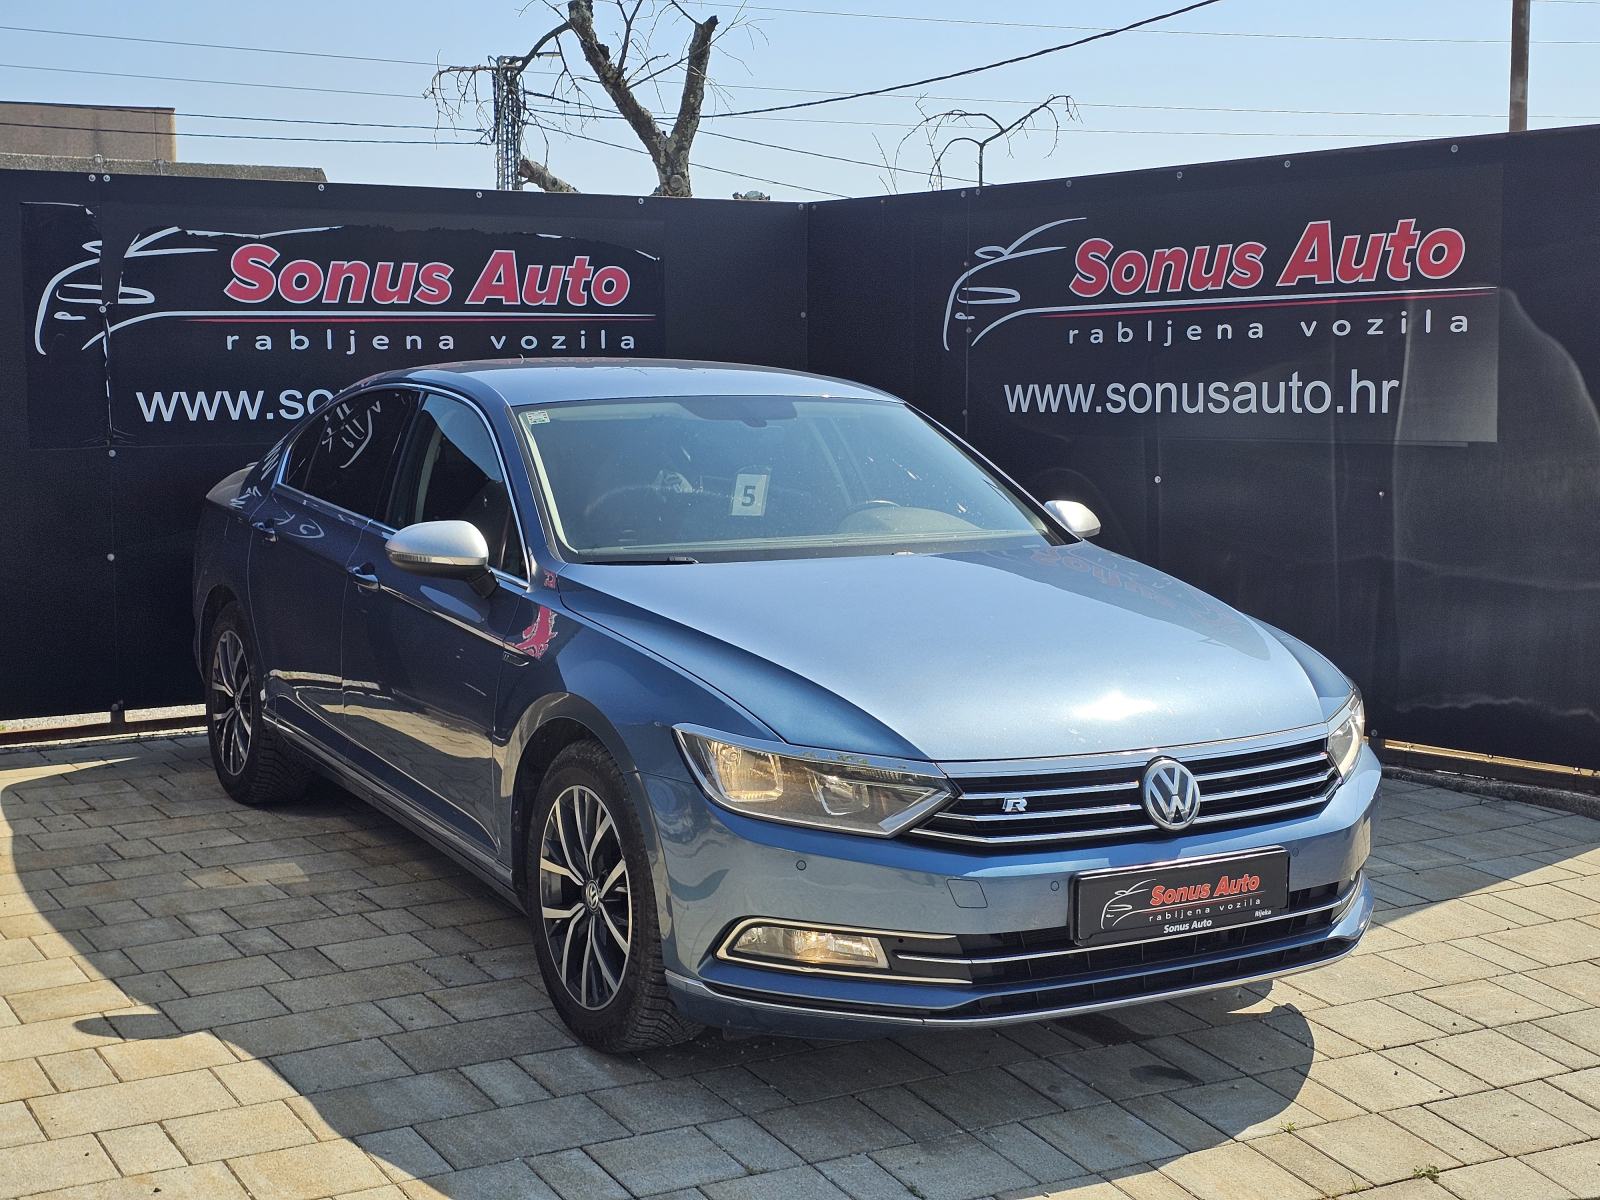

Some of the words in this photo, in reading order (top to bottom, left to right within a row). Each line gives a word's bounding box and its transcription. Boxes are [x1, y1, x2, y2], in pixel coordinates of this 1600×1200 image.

[223, 243, 455, 306] Sonus
[465, 249, 631, 306] Auto
[1068, 236, 1267, 298] Sonus
[1276, 217, 1466, 288] Auto
[225, 328, 455, 356] rabljena
[490, 328, 636, 351] vozila
[1068, 318, 1264, 347] rabljena
[1300, 309, 1470, 337] vozila
[135, 388, 343, 423] www.so
[1003, 368, 1400, 416] www.sonusauto.hr
[742, 485, 756, 508] 5
[1150, 883, 1211, 906] Sonus
[1213, 873, 1261, 897] Auto
[1149, 906, 1211, 922] rabljena
[1219, 897, 1261, 911] vozila
[1163, 920, 1190, 934] Sonus
[1191, 918, 1213, 930] Auto
